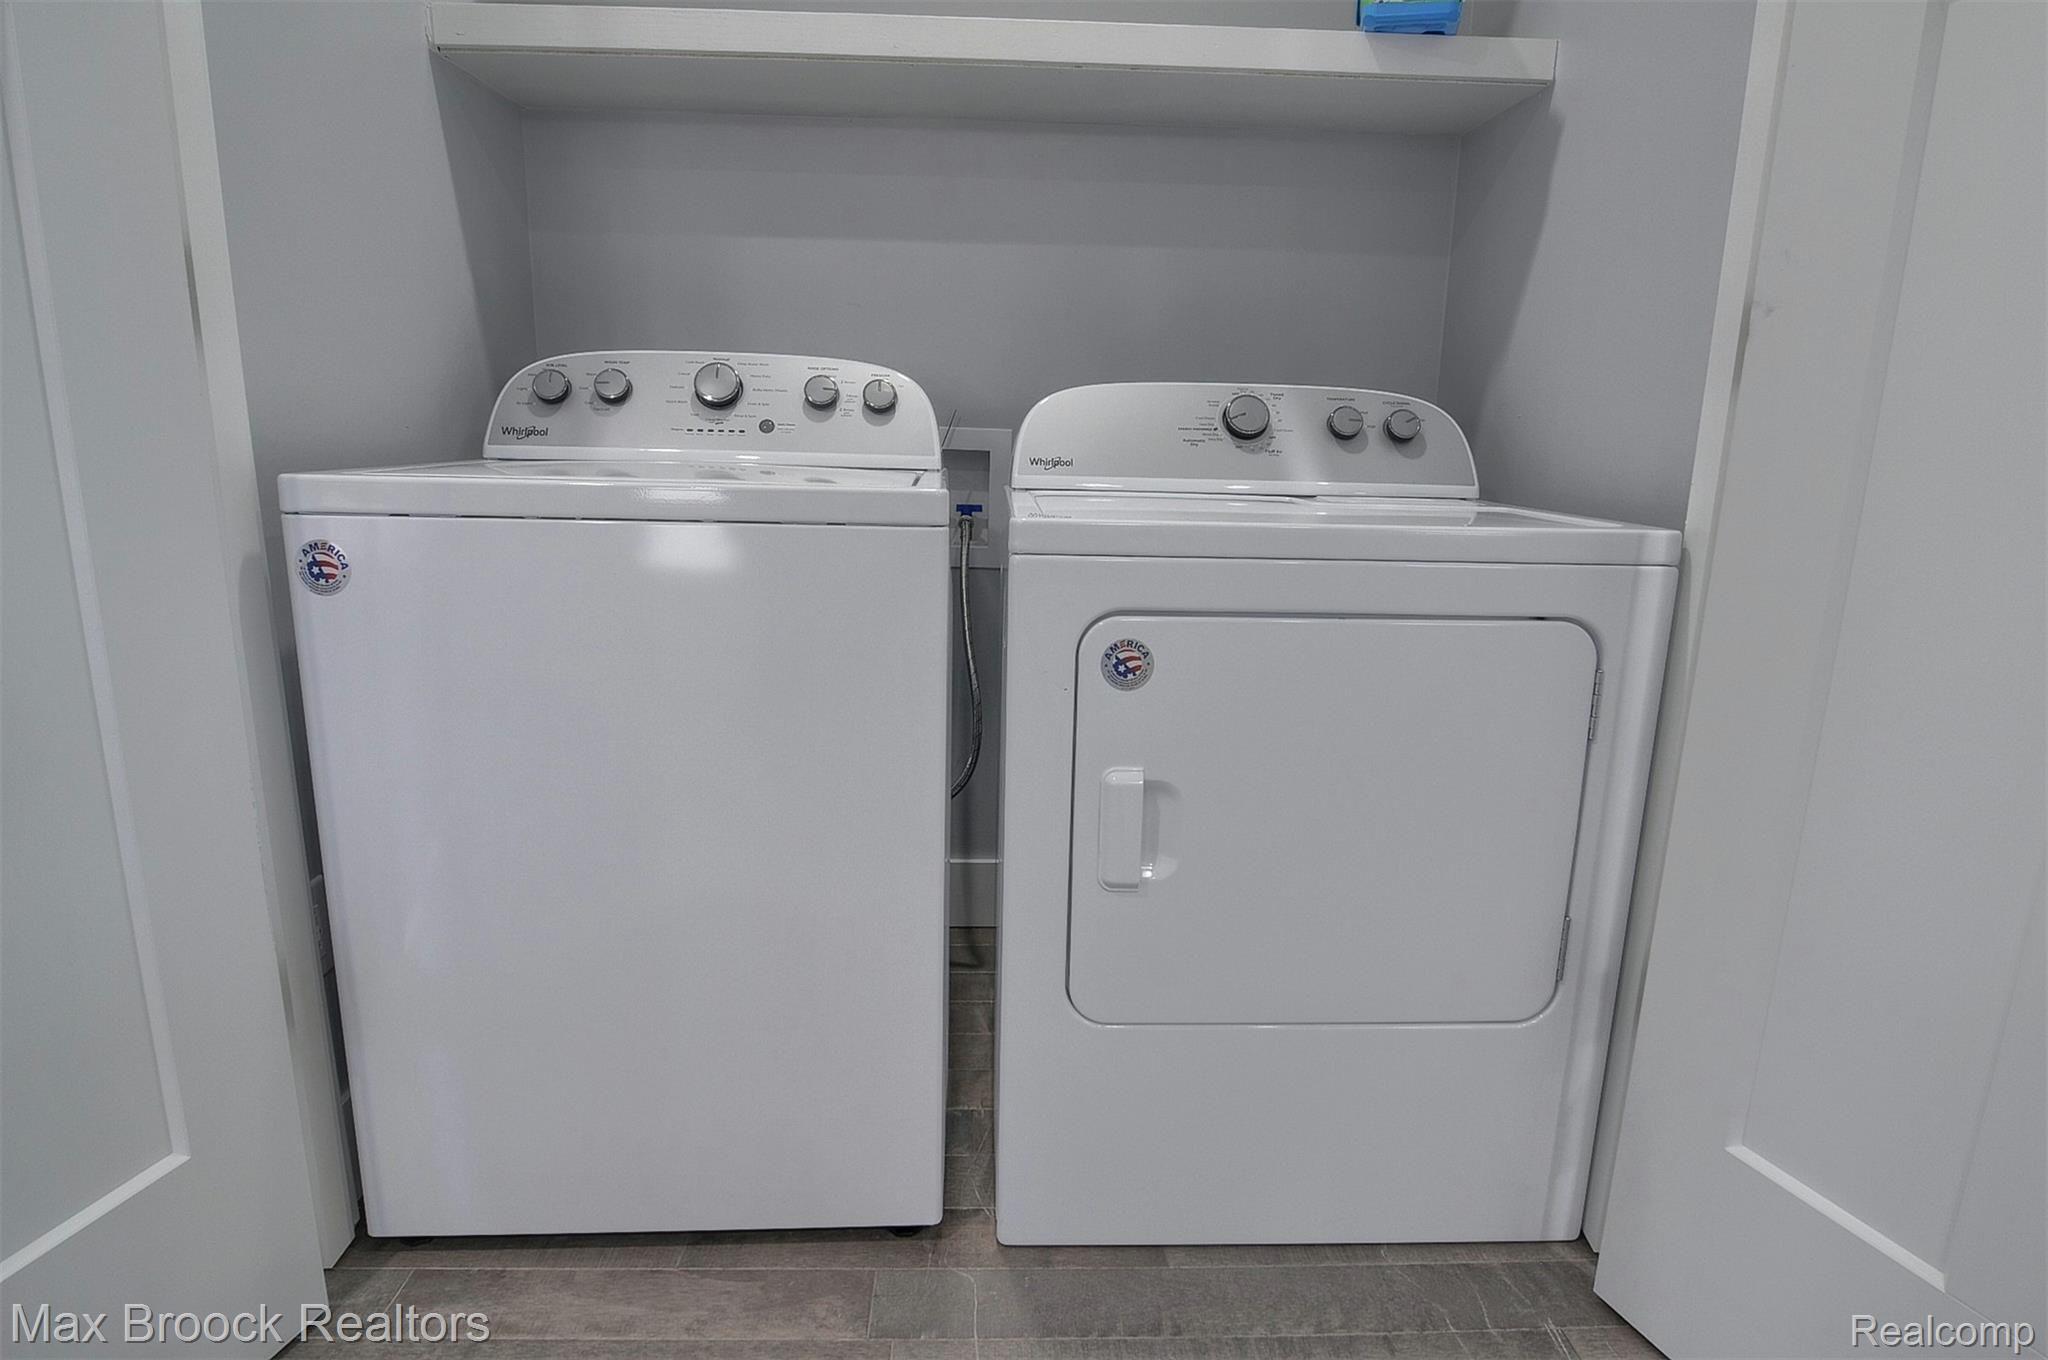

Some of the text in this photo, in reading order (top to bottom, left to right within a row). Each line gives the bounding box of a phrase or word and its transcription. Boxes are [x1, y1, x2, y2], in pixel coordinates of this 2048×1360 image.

[501, 425, 549, 440] Whirlpool
[1029, 456, 1074, 471] Whirlpool
[301, 542, 349, 571] AMERICA
[1104, 640, 1150, 661] AMERICA
